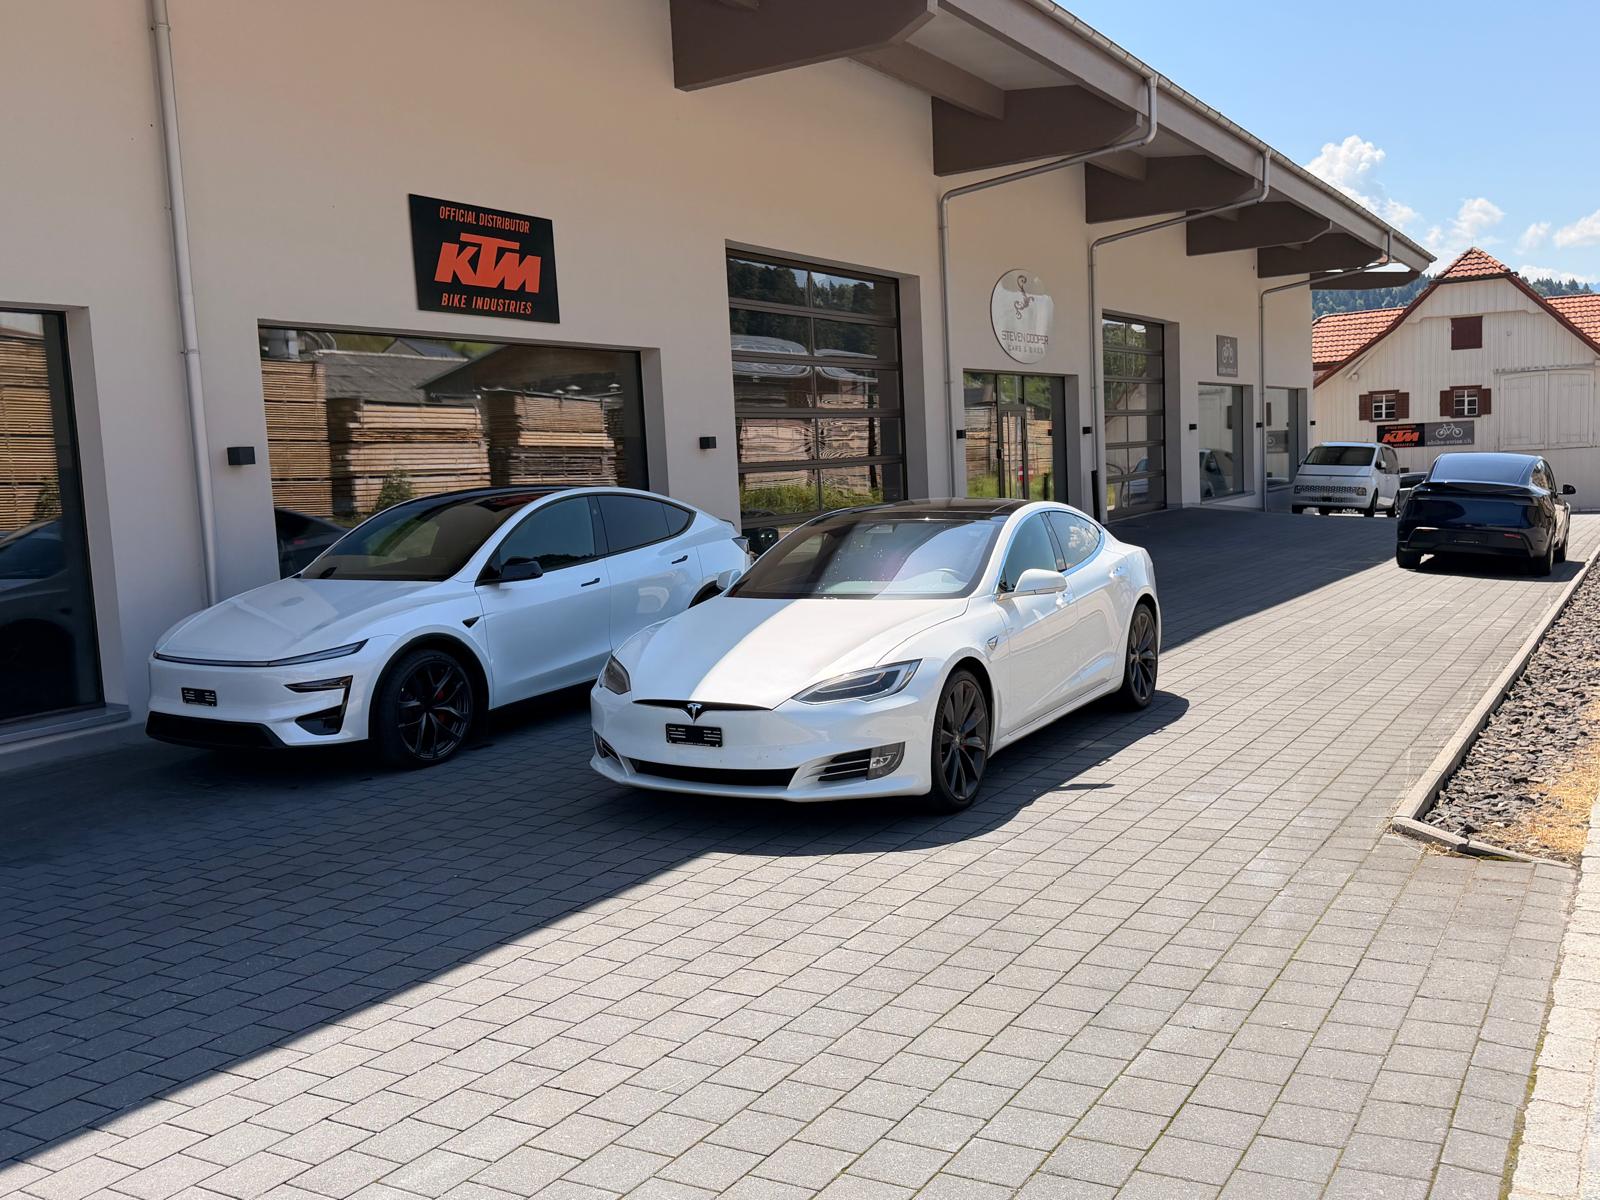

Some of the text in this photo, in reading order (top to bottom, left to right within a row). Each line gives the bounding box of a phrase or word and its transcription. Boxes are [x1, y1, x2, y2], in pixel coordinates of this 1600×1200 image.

[439, 206, 530, 234] OFFICIAL DISTRIBUTOR
[434, 232, 542, 294] KTM
[441, 293, 532, 315] BIKE INDUSTRIES
[1001, 330, 1049, 345] STEVEN COOPER
[1382, 430, 1420, 443] KTM
